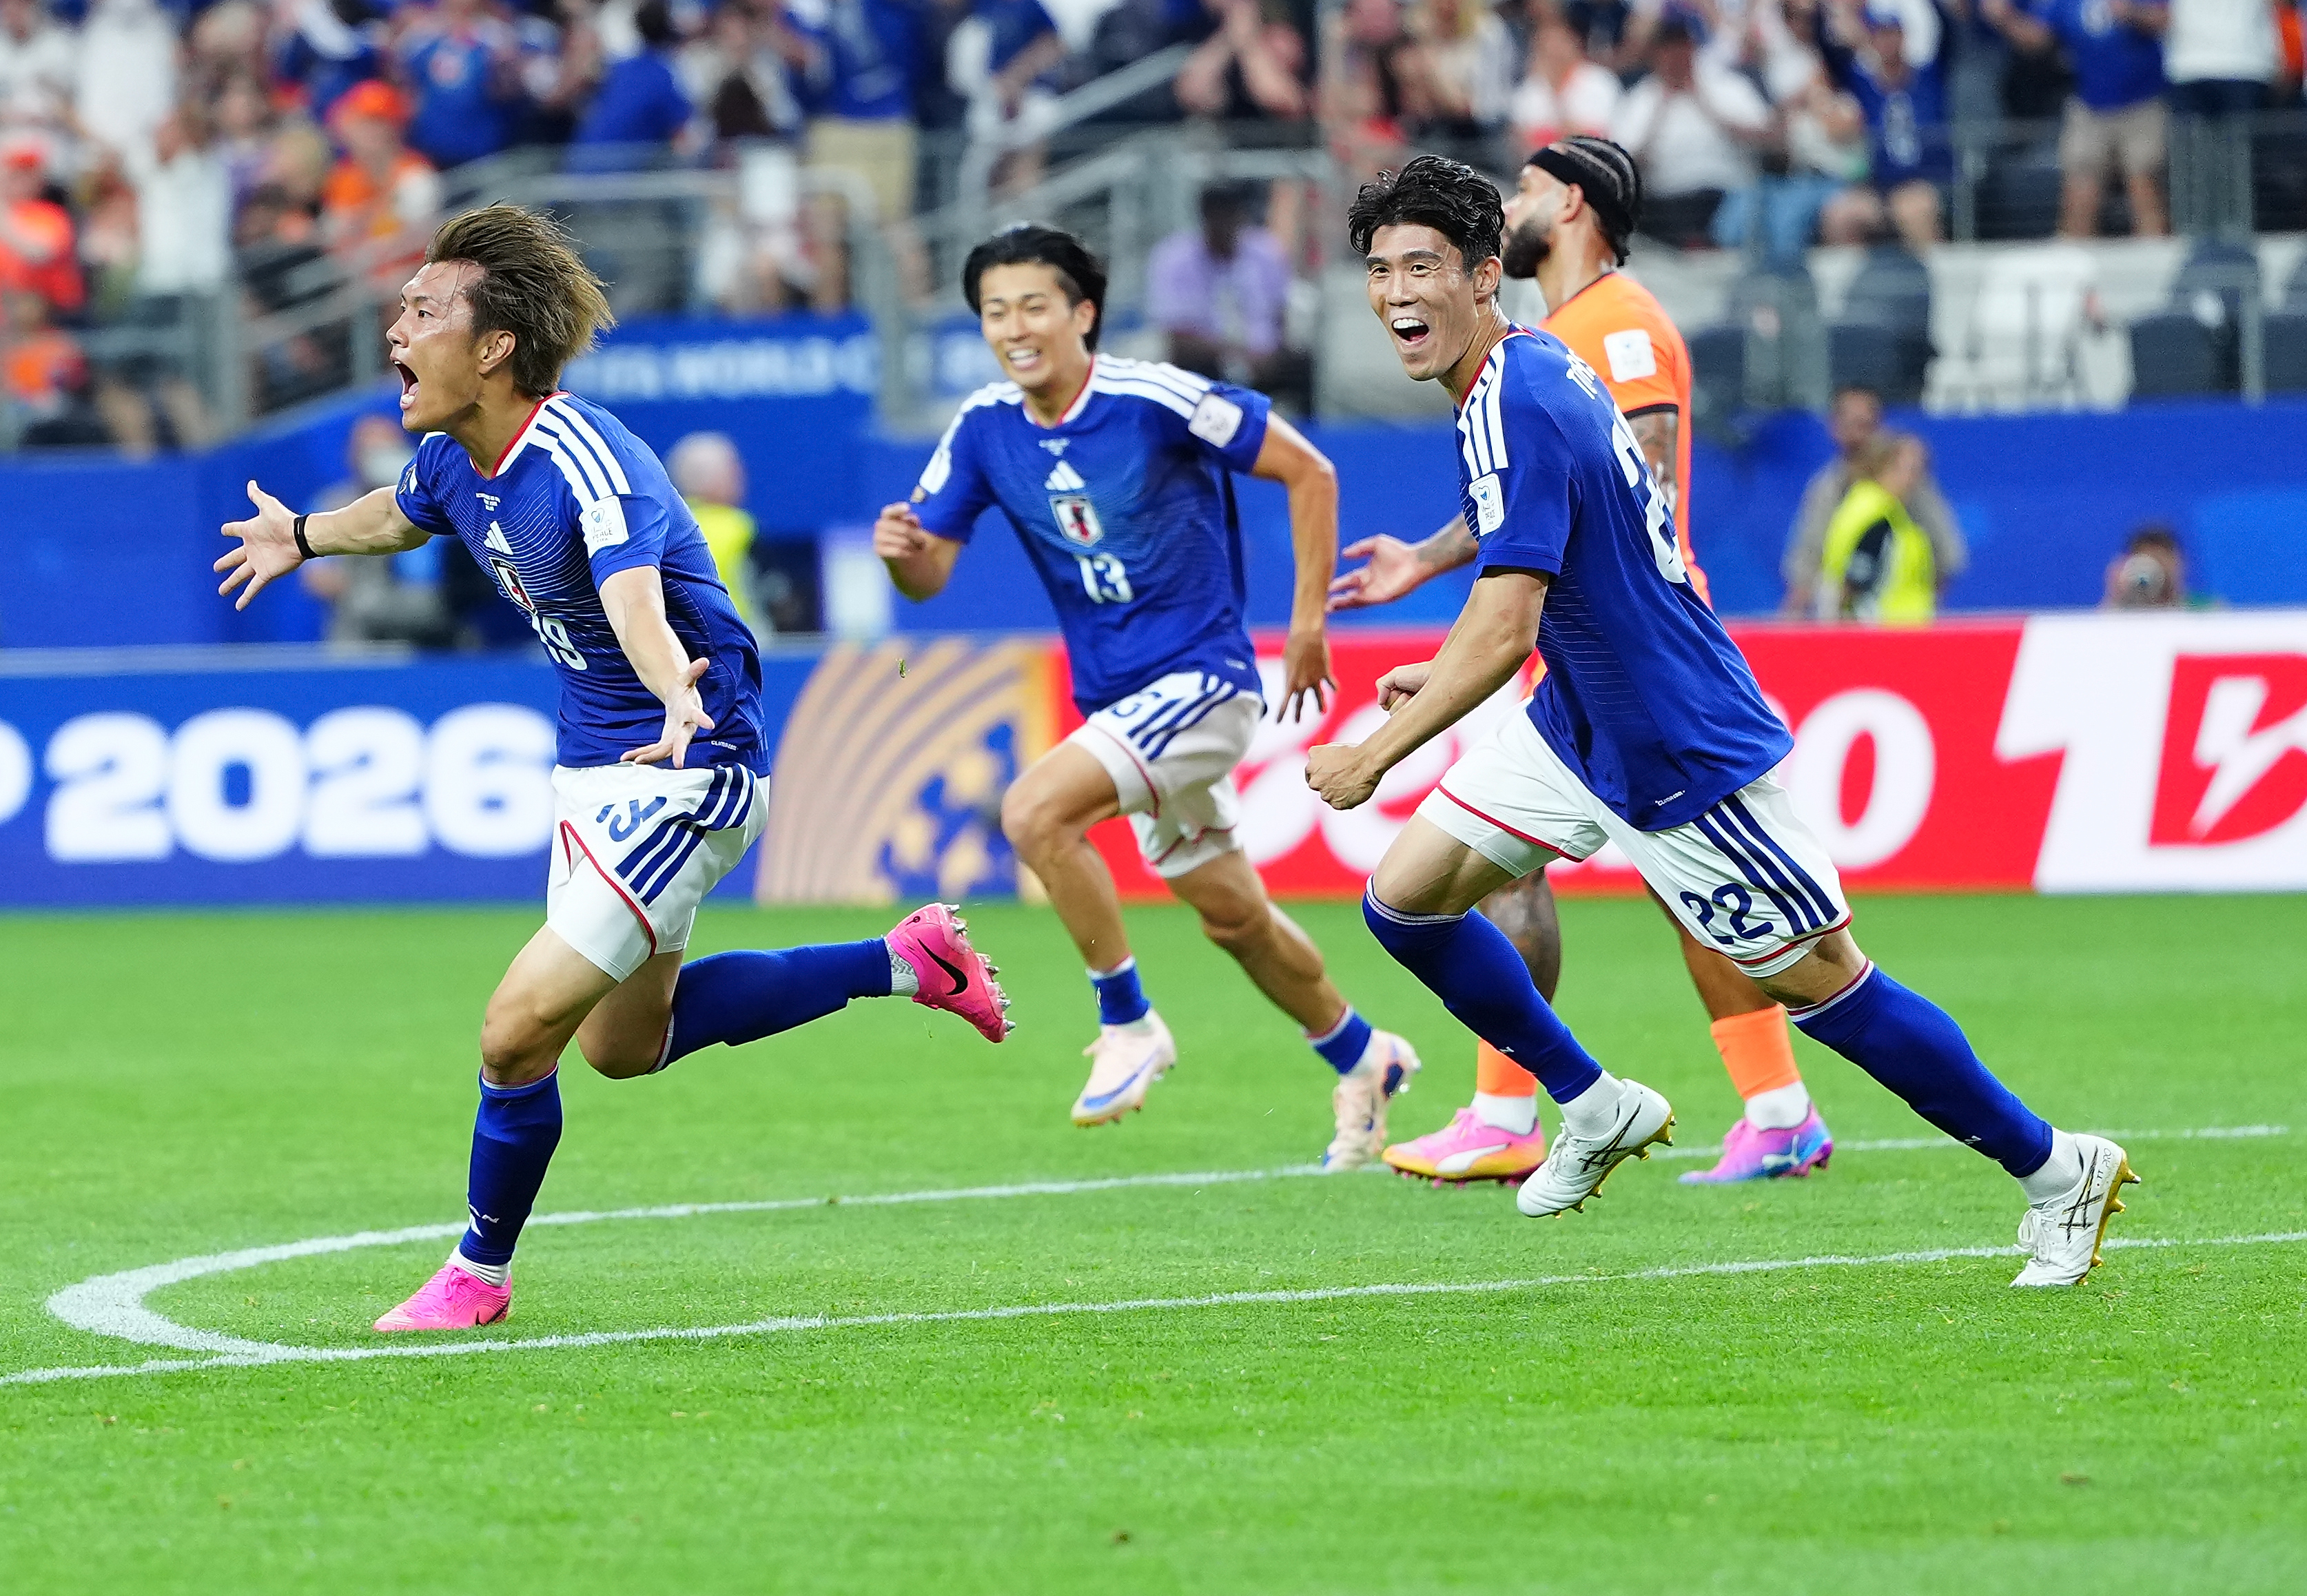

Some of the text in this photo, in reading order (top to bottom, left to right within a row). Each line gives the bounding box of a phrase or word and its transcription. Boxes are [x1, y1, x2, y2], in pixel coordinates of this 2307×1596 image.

[1074, 552, 1135, 604] 13
[45, 702, 557, 861] 2026
[1679, 882, 1774, 945] 22
